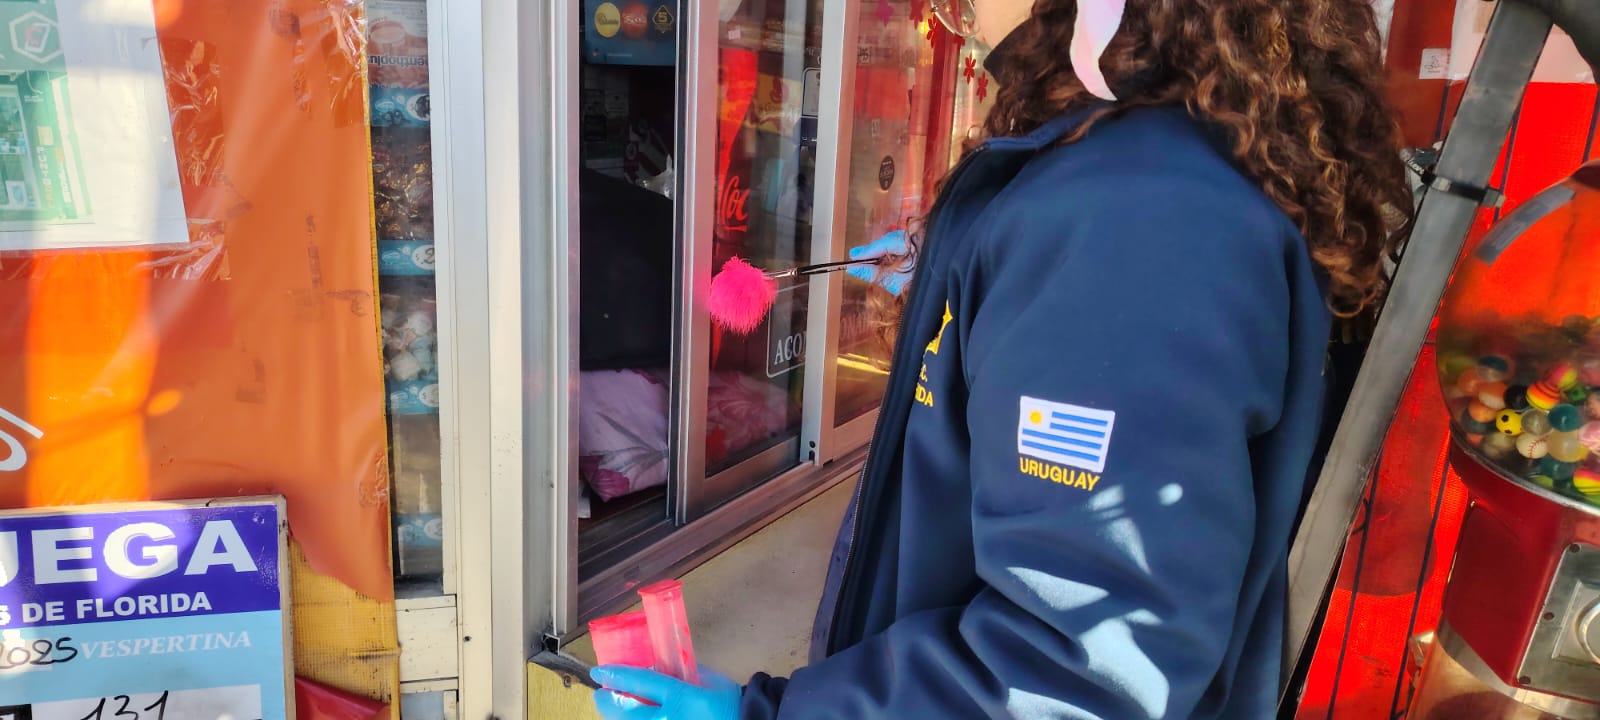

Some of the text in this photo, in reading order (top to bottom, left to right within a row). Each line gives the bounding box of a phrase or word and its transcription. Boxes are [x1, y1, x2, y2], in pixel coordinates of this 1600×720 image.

[367, 54, 428, 67] enthoplu
[1019, 457, 1100, 491] URUGUAY
[22, 601, 65, 623] DE
[76, 591, 212, 619] FLORIDA
[80, 630, 252, 660] VESPERTINA
